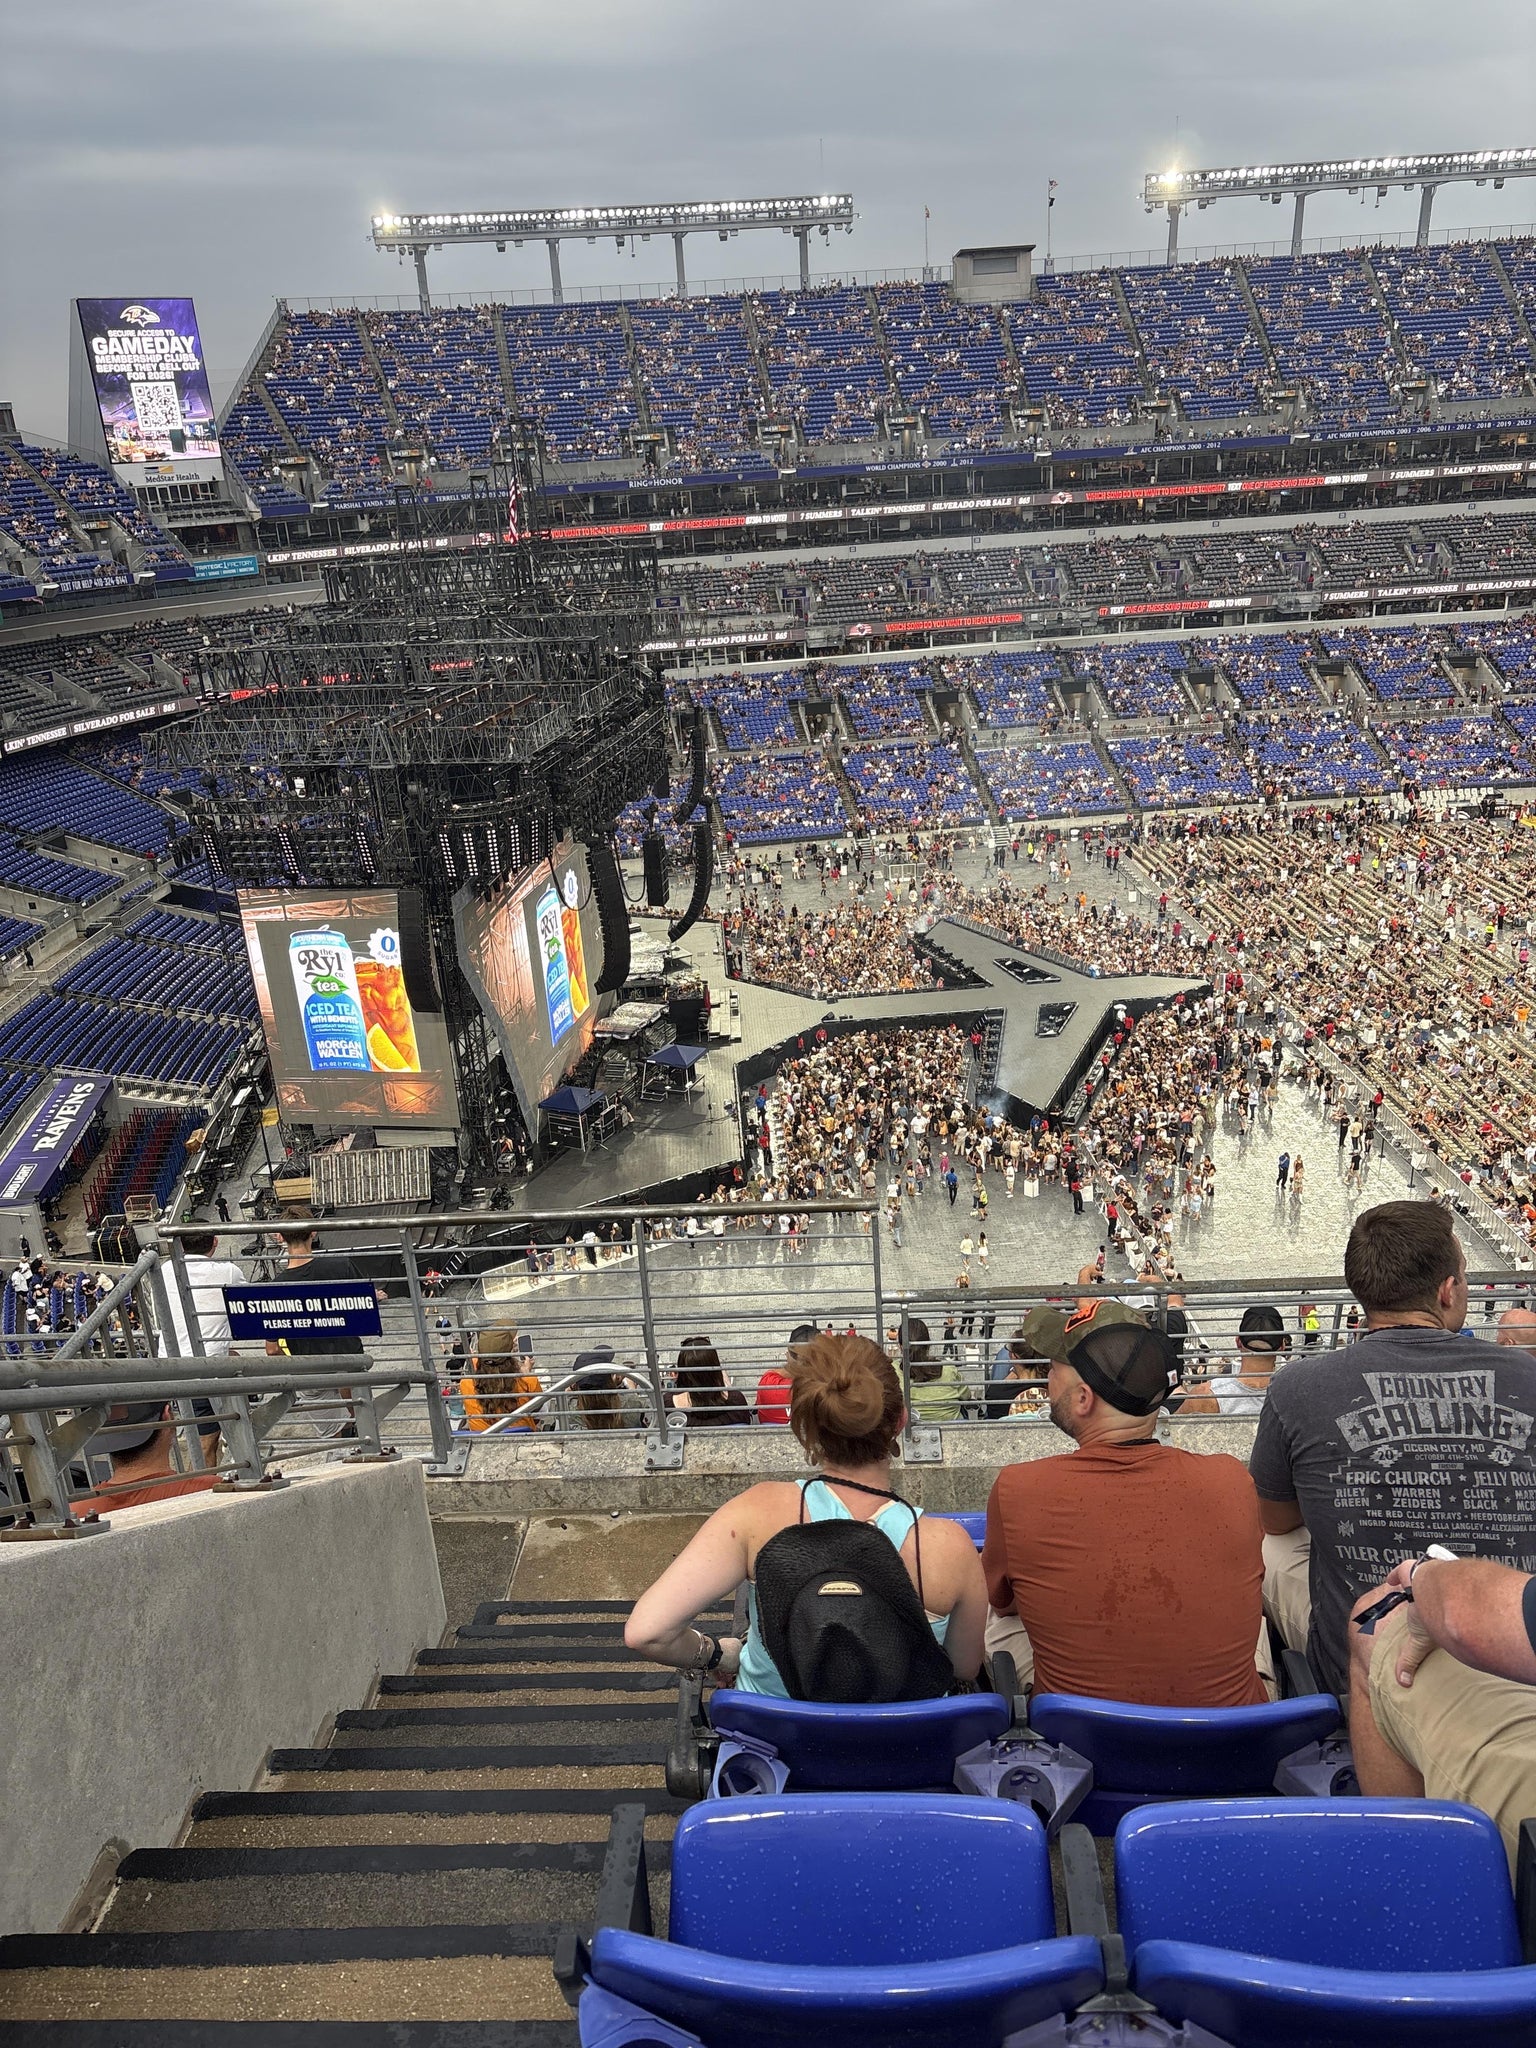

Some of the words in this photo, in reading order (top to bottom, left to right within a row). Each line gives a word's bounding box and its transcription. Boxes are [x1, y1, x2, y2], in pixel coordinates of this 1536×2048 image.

[92, 336, 194, 355] GAMEDAY
[94, 354, 162, 364] MEMBERSHIP
[96, 364, 133, 373] BEFORE
[134, 363, 158, 372] THEY
[159, 362, 181, 370] SELL
[182, 360, 200, 370] OUT
[127, 372, 146, 380] FOR
[147, 372, 174, 380] 2026!
[1360, 429, 1395, 437] CHAMPIONS
[1152, 444, 1186, 452] CHAMPIONS
[866, 464, 886, 472] WORLD
[887, 462, 920, 471] CHAMPIONS
[1395, 469, 1434, 479] SUMMERS
[1444, 466, 1476, 475] TALKIN'
[1477, 462, 1523, 473] TENNESSEE
[145, 473, 175, 483] MedStar
[176, 473, 200, 481] Health
[629, 480, 648, 488] RING
[654, 478, 683, 486] HONOR
[1228, 483, 1242, 491] TEXT
[1342, 475, 1350, 483] TO
[436, 494, 460, 502] TERRELL
[1086, 492, 1106, 500] WHICH
[1107, 491, 1122, 499] SONG
[1161, 488, 1170, 496] TO
[1170, 487, 1185, 495] HEAR
[334, 502, 361, 510] MARSHAL
[806, 510, 842, 519] SUMMERS
[851, 508, 882, 516] TALKIN'
[883, 504, 925, 514] TENNESSEE
[932, 500, 975, 510] SILVERADO
[976, 499, 991, 508] FOR
[992, 498, 1012, 506] SALE
[650, 522, 664, 531] TEXT
[763, 515, 770, 523] TO
[292, 550, 337, 560] TENNESSEE
[345, 544, 390, 555] SILVERADO
[227, 560, 253, 568] FACTORY
[60, 581, 71, 592] TEXT
[72, 581, 81, 590] FOR
[81, 579, 93, 589] HELP
[1329, 590, 1368, 600] SUMMERS
[1377, 588, 1411, 597] TALKIN'
[1412, 584, 1458, 595] TENNESSEE
[1465, 581, 1512, 590] SILVERADO
[1514, 580, 1529, 588] FOR
[1110, 606, 1125, 614] TEXT
[1226, 599, 1234, 607] TO
[731, 636, 746, 644] FOR
[748, 634, 768, 642] SALE
[26, 727, 67, 746] TENNESSEE
[74, 714, 118, 733] SILVERADO
[120, 710, 135, 722] FOR
[136, 706, 155, 720] SALE
[163, 702, 176, 713] 865
[380, 936, 395, 952] 0
[320, 948, 334, 956] the
[298, 950, 344, 978] Ryl
[317, 981, 339, 992] tea
[306, 1002, 334, 1016] ICED
[336, 1002, 358, 1015] TEA
[310, 1015, 327, 1024] WITH
[327, 1015, 360, 1024] BENEFITS
[316, 1040, 360, 1049] MORGAN
[318, 1048, 364, 1060] WALLEN
[32, 1082, 95, 1152] RAVENS
[228, 1300, 245, 1314] NO
[248, 1299, 304, 1314] STANDING
[305, 1298, 321, 1312] ON
[325, 1296, 374, 1311] LANDING
[263, 1319, 292, 1329] PLEASE
[293, 1318, 312, 1328] KEEP
[313, 1317, 346, 1328] MOVING
[1378, 1375, 1488, 1399] COUNTRY
[1358, 1401, 1514, 1443] CALLING
[1403, 1443, 1439, 1452] OCEAN
[1440, 1444, 1469, 1454] CITY,
[1471, 1444, 1486, 1453] MD
[1378, 1450, 1394, 1461] 20
[1496, 1450, 1509, 1462] 24
[1346, 1471, 1381, 1485] ERIC
[1384, 1471, 1451, 1486] CHURCH
[1473, 1471, 1508, 1487] JELLY
[1336, 1488, 1366, 1498] RILEY
[1391, 1488, 1440, 1498] WARREN
[1463, 1489, 1495, 1499] CLINT
[1334, 1498, 1370, 1508] GREEN
[1393, 1499, 1442, 1509] ZEIDERS
[1464, 1500, 1498, 1510] BLACK
[1366, 1509, 1383, 1518] THE
[1386, 1510, 1404, 1519] RED
[1407, 1511, 1427, 1520] CLAY
[1430, 1512, 1462, 1521] STRAYS
[1471, 1513, 1533, 1522] NEEDTOBREATHE
[1389, 1521, 1424, 1530] ANDRESS
[1432, 1522, 1449, 1530] ELLA
[1451, 1523, 1484, 1531] LANGLEY
[1335, 1546, 1379, 1562] TYLER
